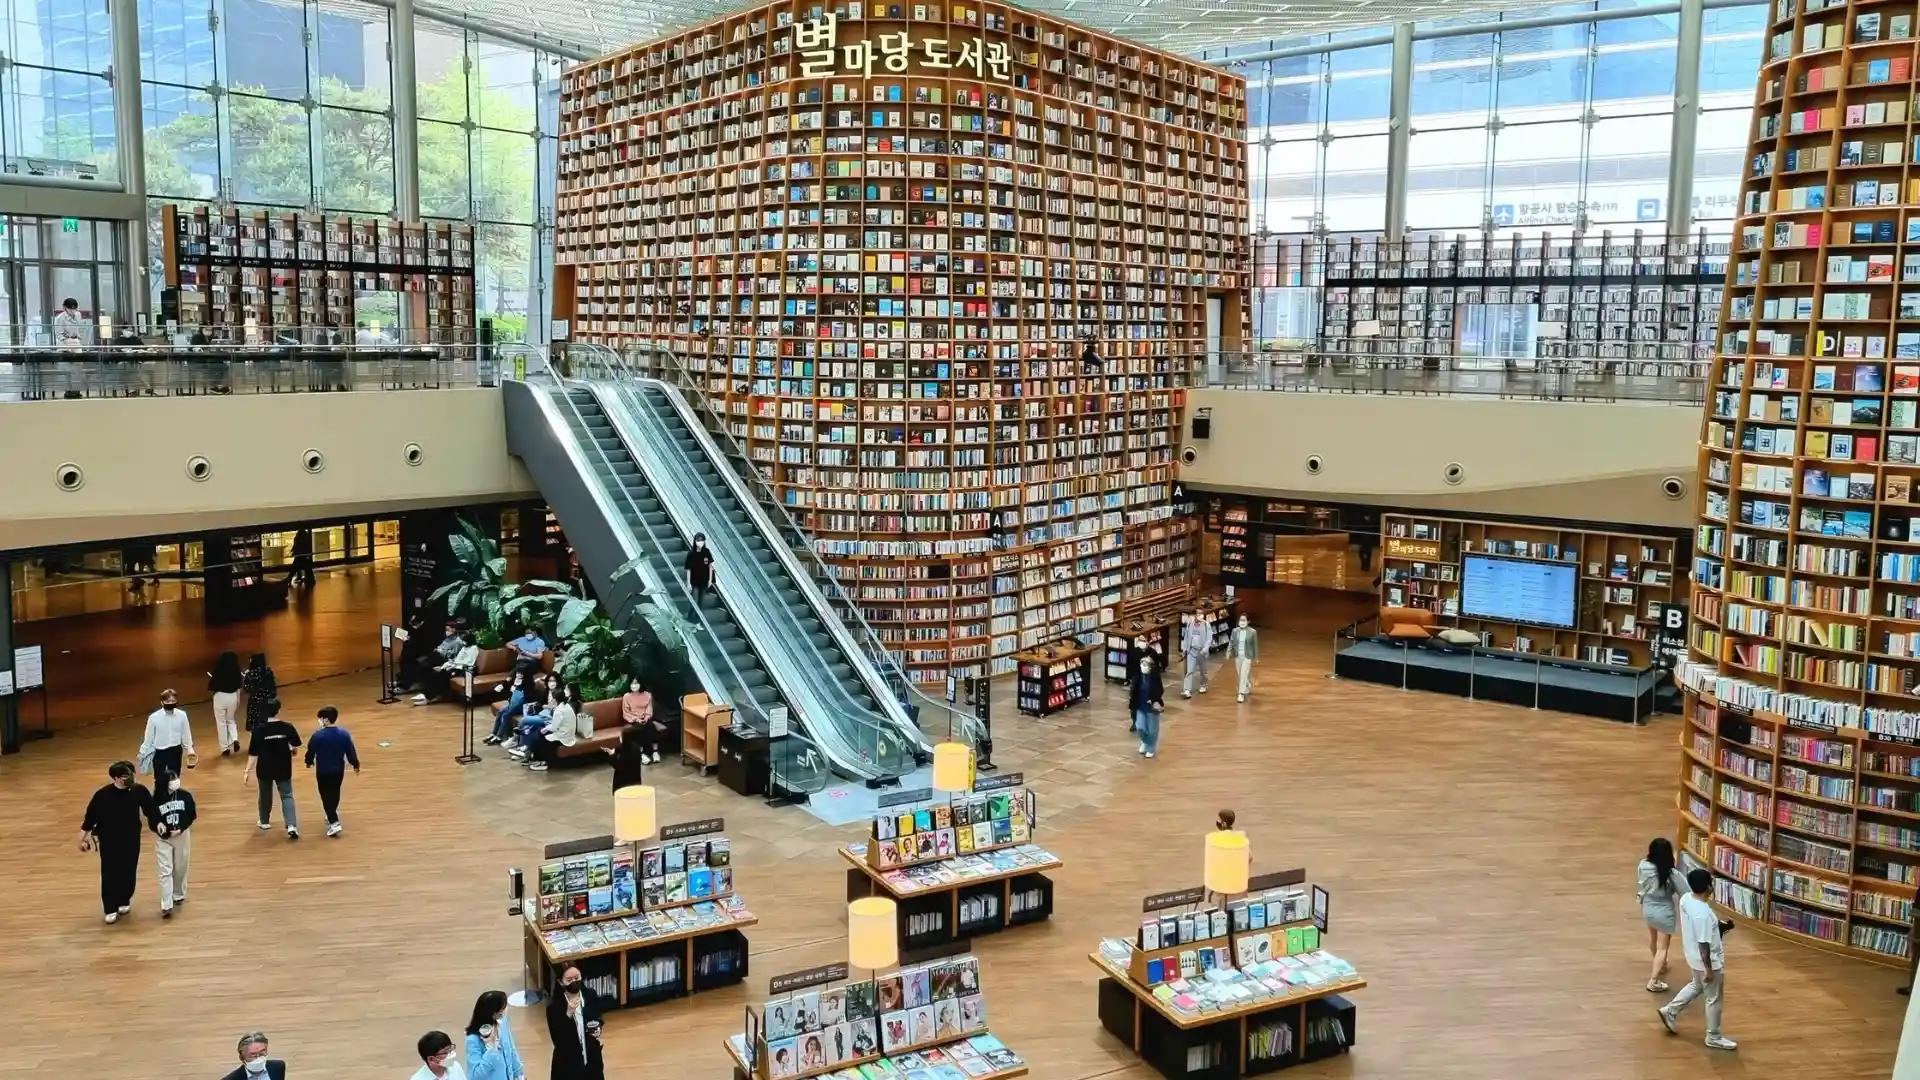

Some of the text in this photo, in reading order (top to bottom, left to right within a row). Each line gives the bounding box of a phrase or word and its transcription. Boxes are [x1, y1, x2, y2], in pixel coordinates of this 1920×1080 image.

[1174, 485, 1183, 496] A
[993, 514, 1001, 528] A
[1666, 609, 1682, 628] B
